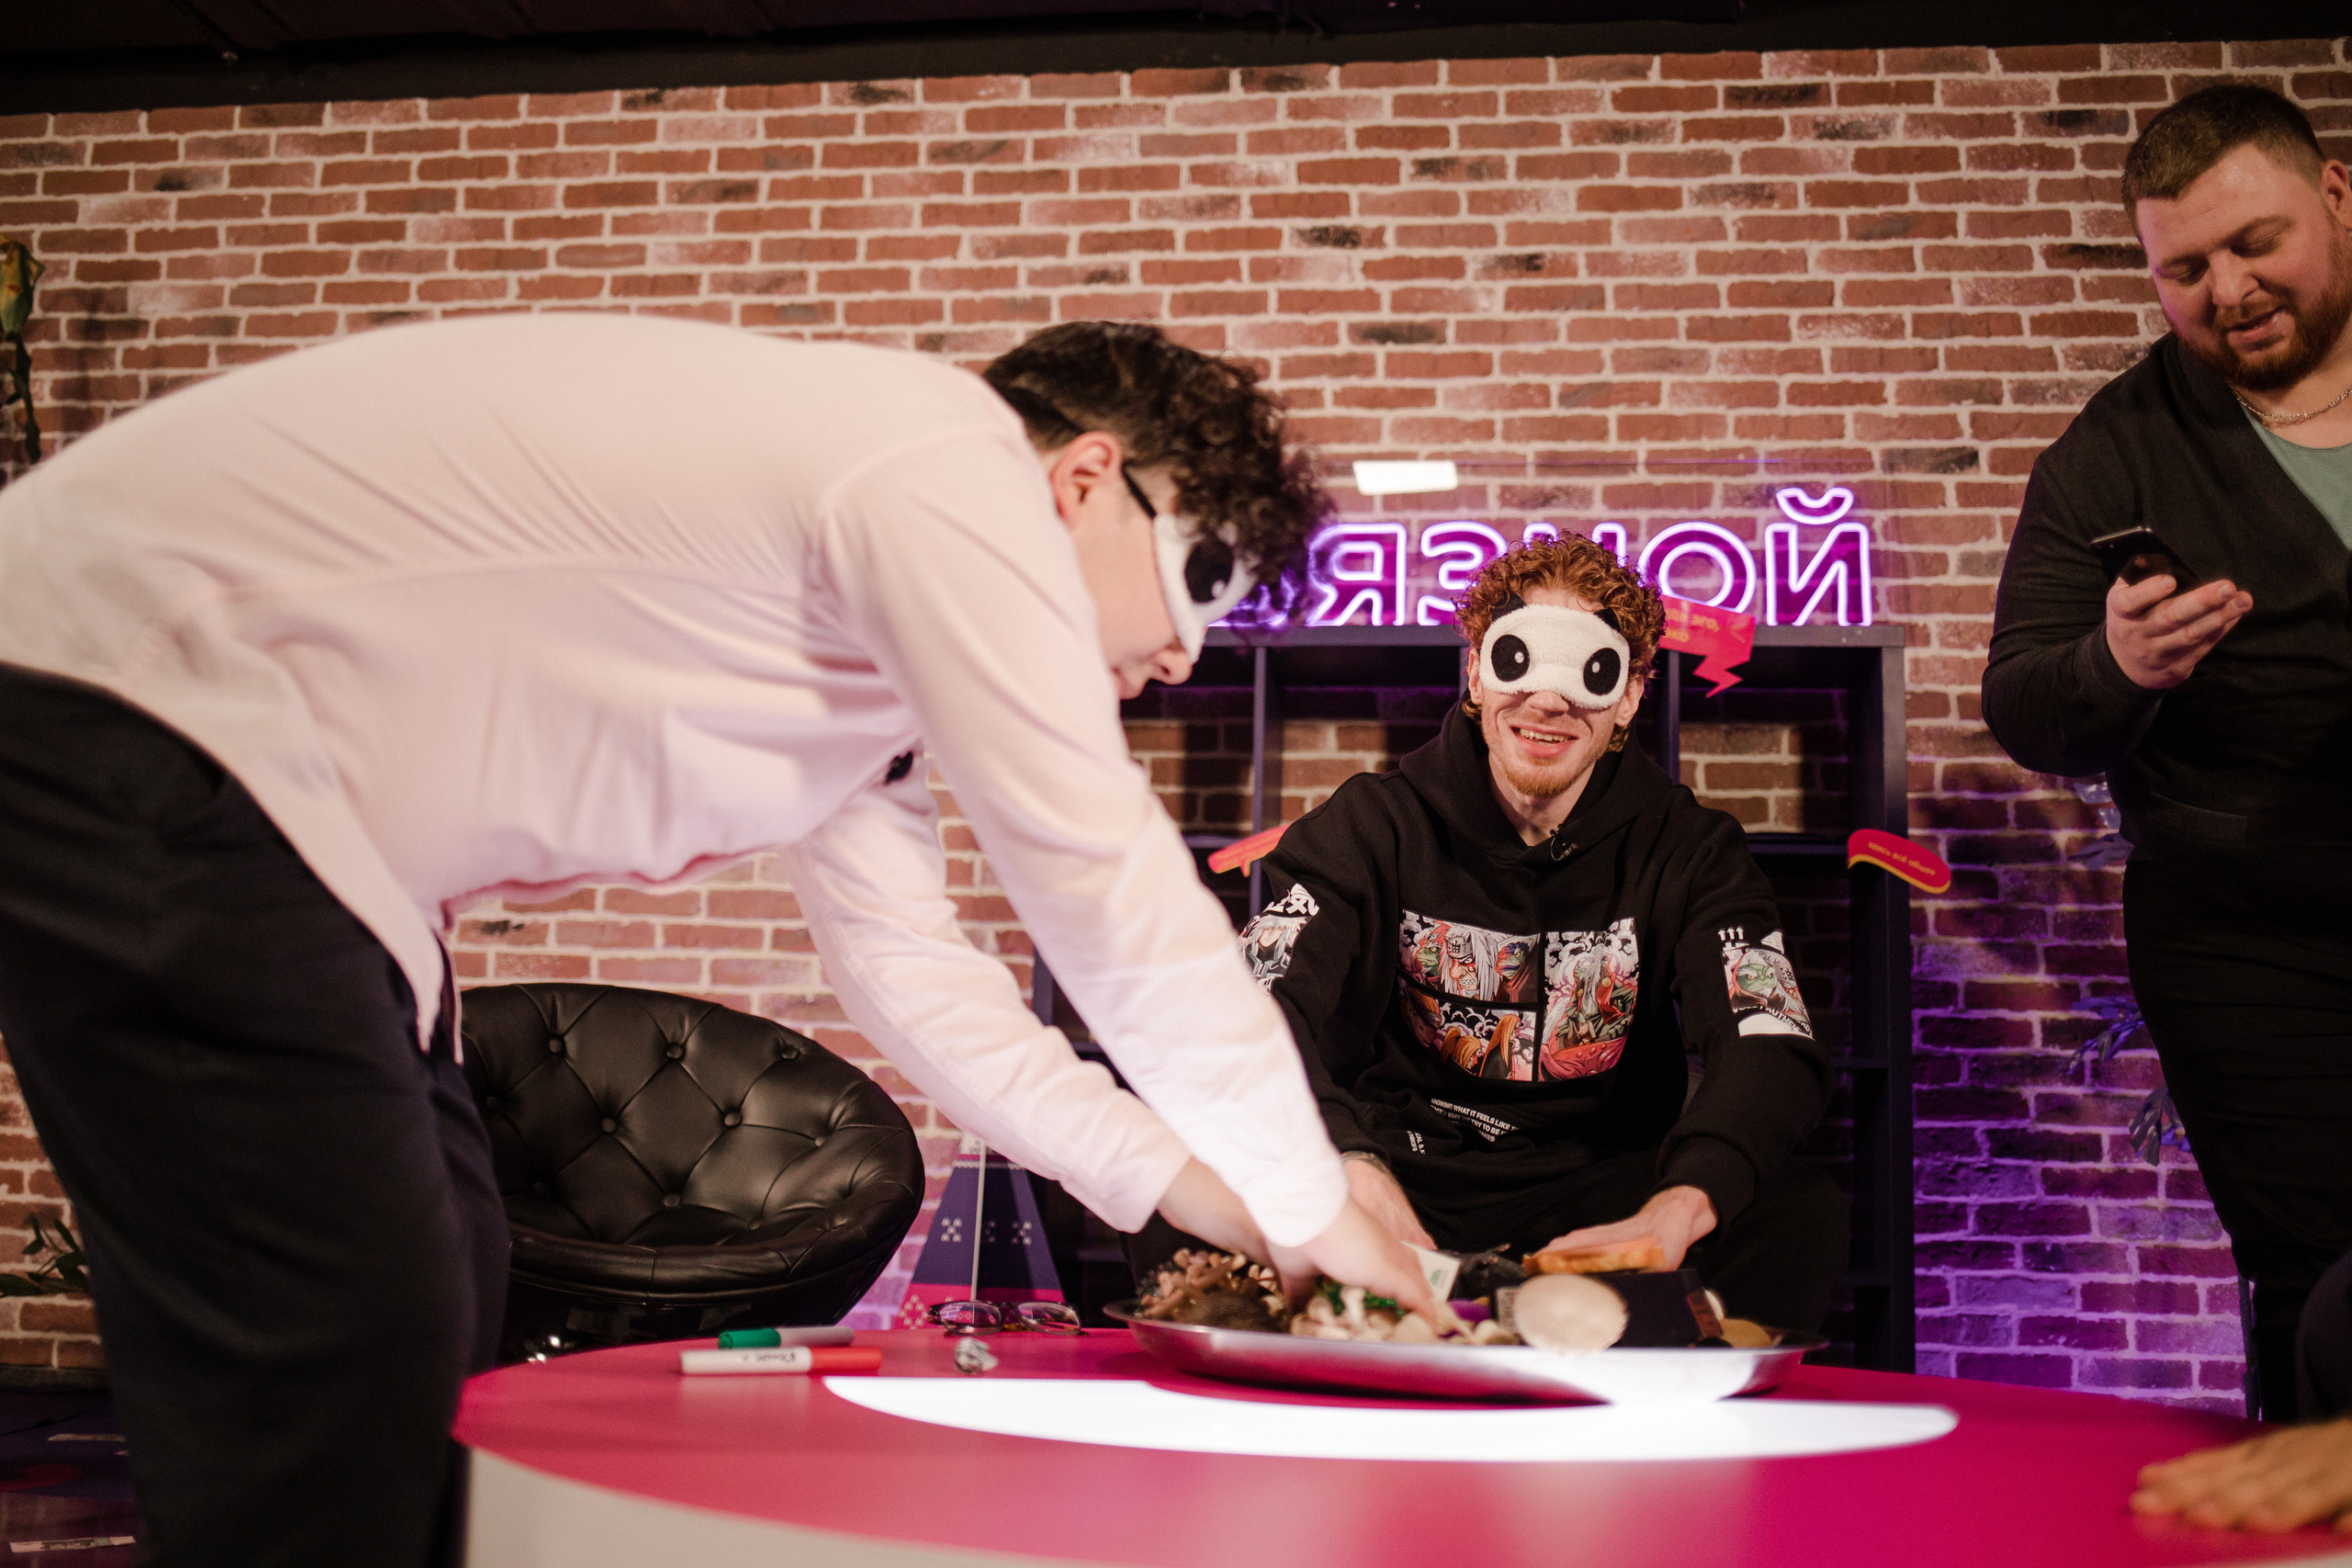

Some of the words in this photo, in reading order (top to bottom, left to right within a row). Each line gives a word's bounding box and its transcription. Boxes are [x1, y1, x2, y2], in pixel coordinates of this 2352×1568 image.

[1453, 1104, 1471, 1115] WHAT
[1470, 1110, 1477, 1118] IT
[1476, 1111, 1496, 1124] FEELS
[1495, 1119, 1511, 1131] LIKE
[1482, 1122, 1491, 1132] TO
[1490, 1126, 1501, 1136] BE
